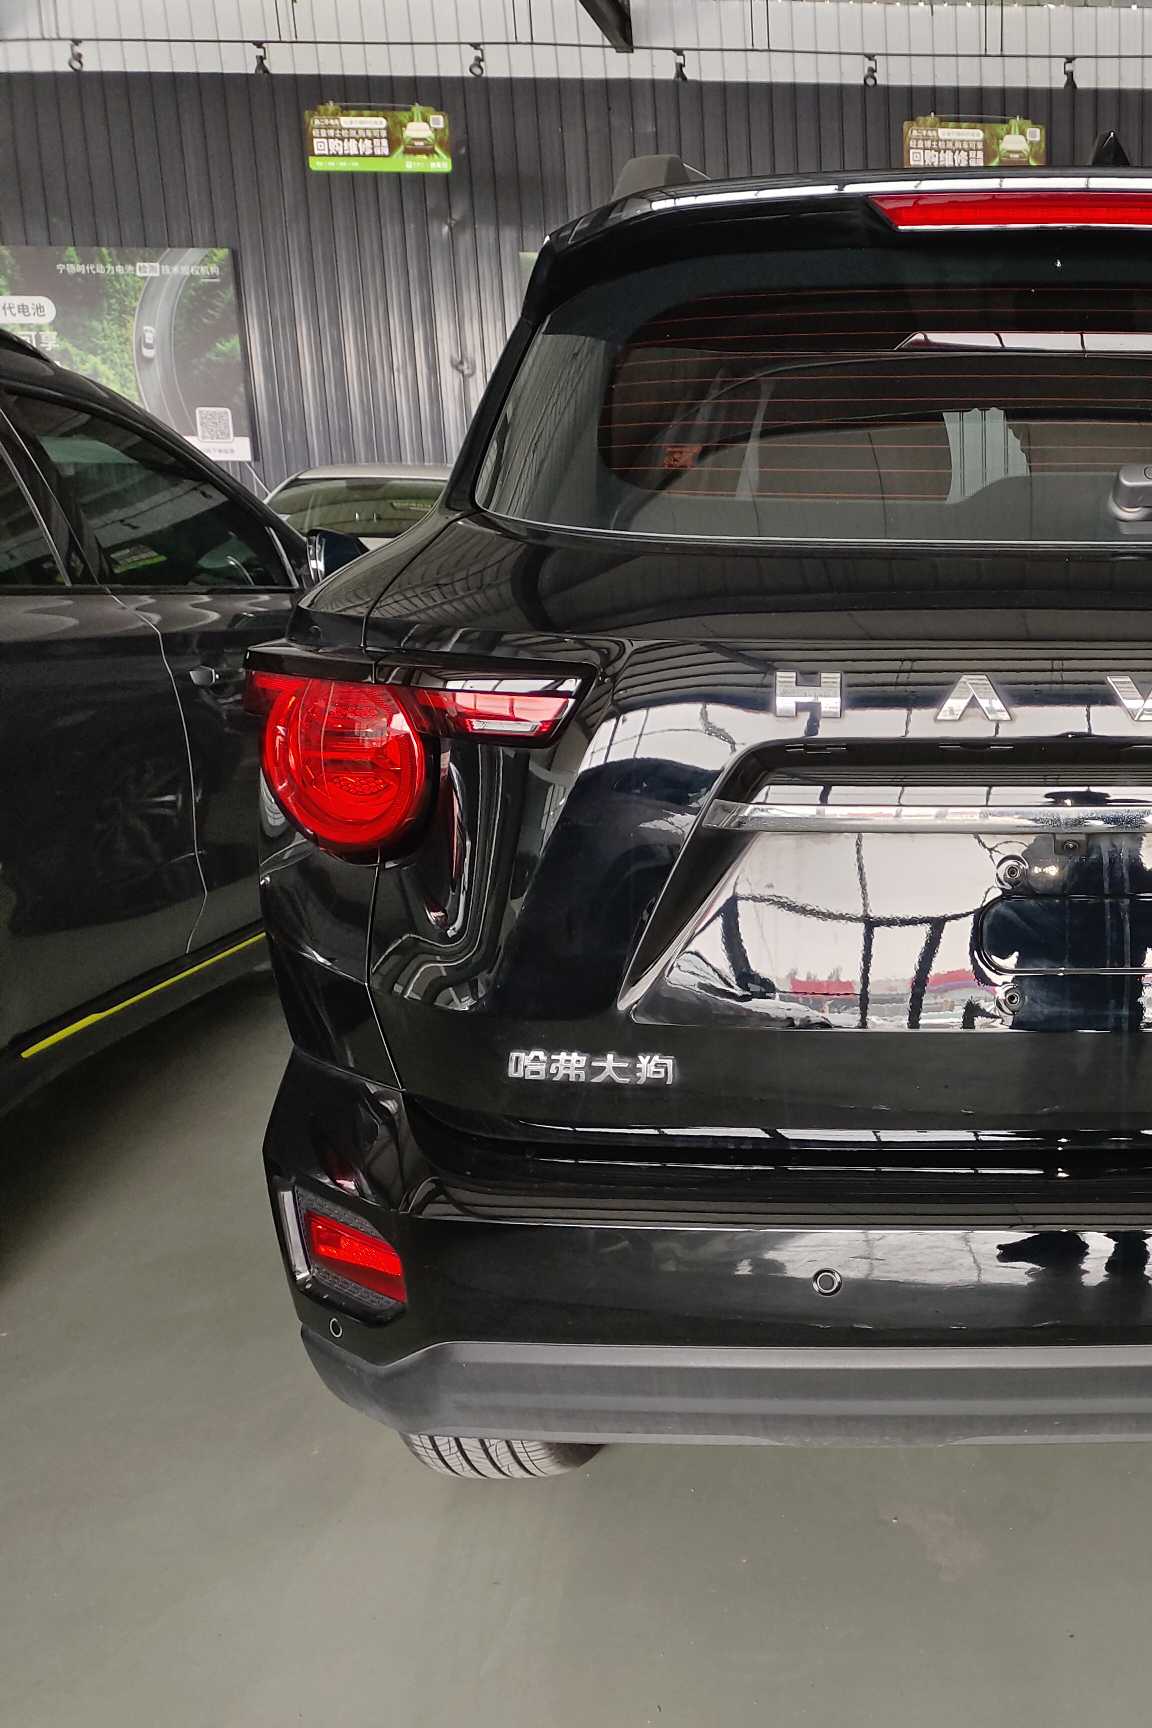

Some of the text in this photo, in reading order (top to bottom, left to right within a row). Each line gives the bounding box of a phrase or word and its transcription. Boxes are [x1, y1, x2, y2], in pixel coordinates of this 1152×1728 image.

[2, 303, 46, 317] 代电池
[508, 1050, 675, 1085] 哈弗大狗
